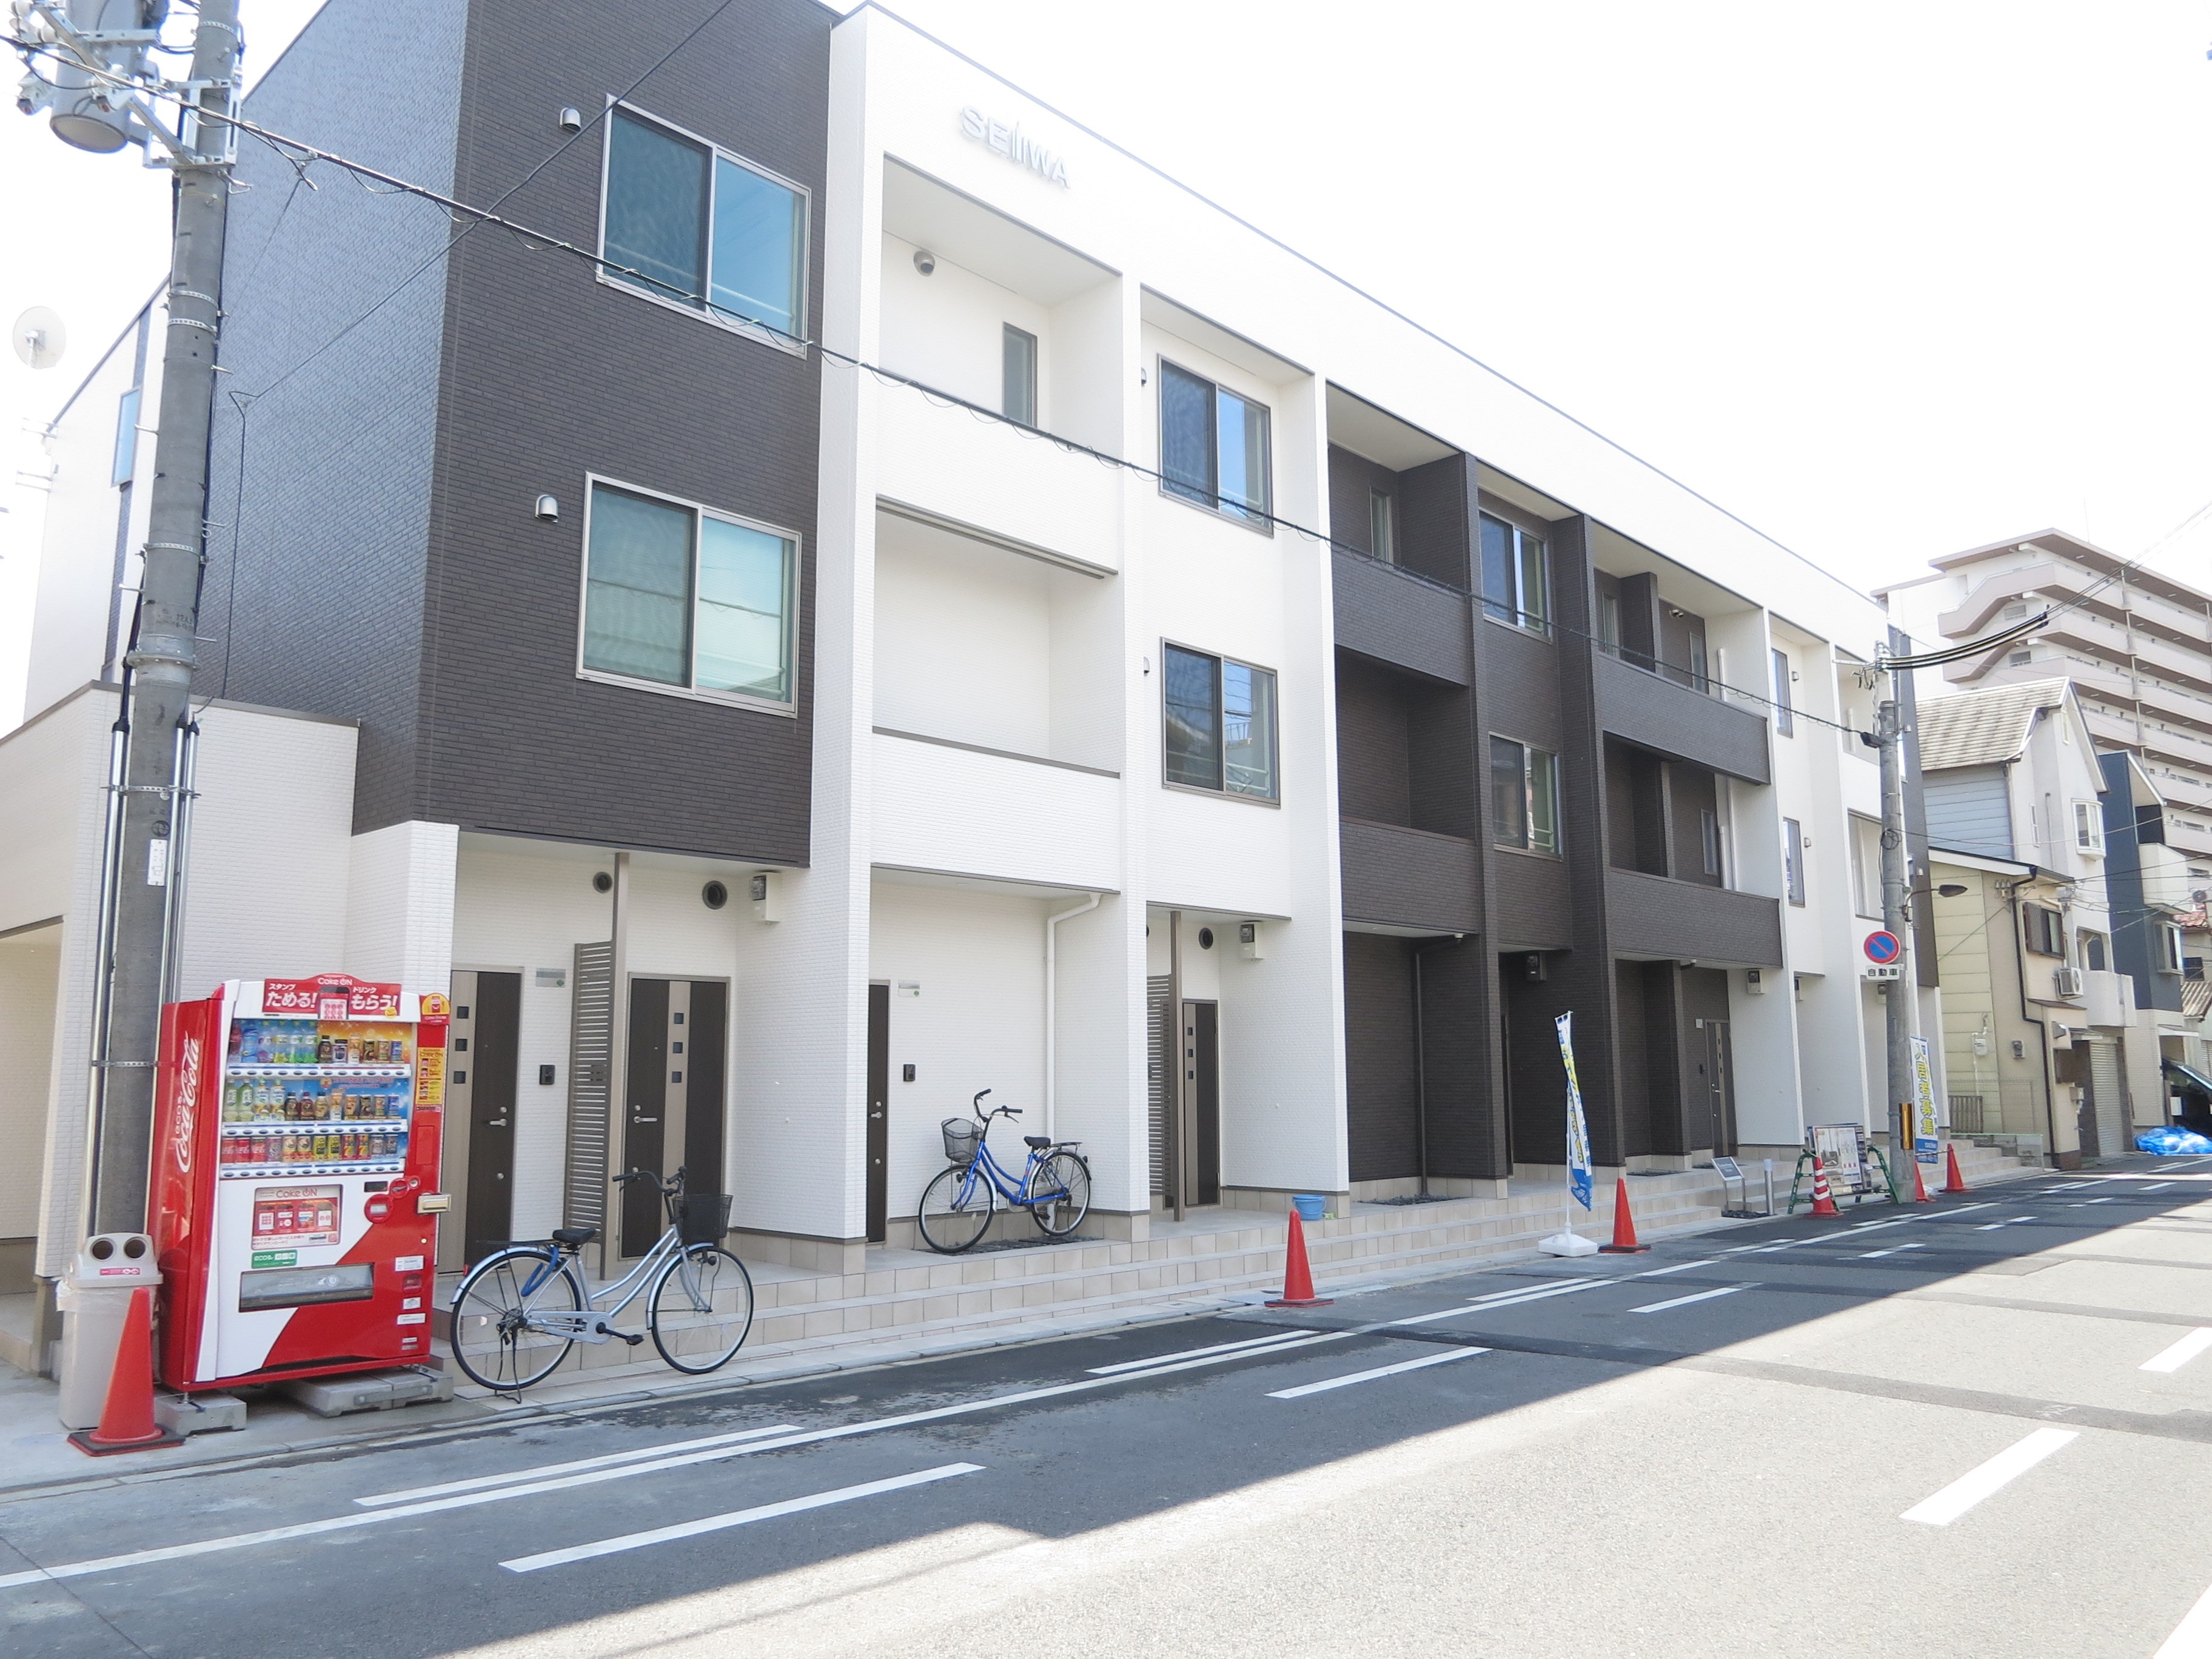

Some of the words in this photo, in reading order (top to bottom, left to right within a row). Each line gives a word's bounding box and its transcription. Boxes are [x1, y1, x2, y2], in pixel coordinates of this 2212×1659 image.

[1914, 1042, 1935, 1136] 入居者募集
[276, 1190, 301, 1198] Coke
